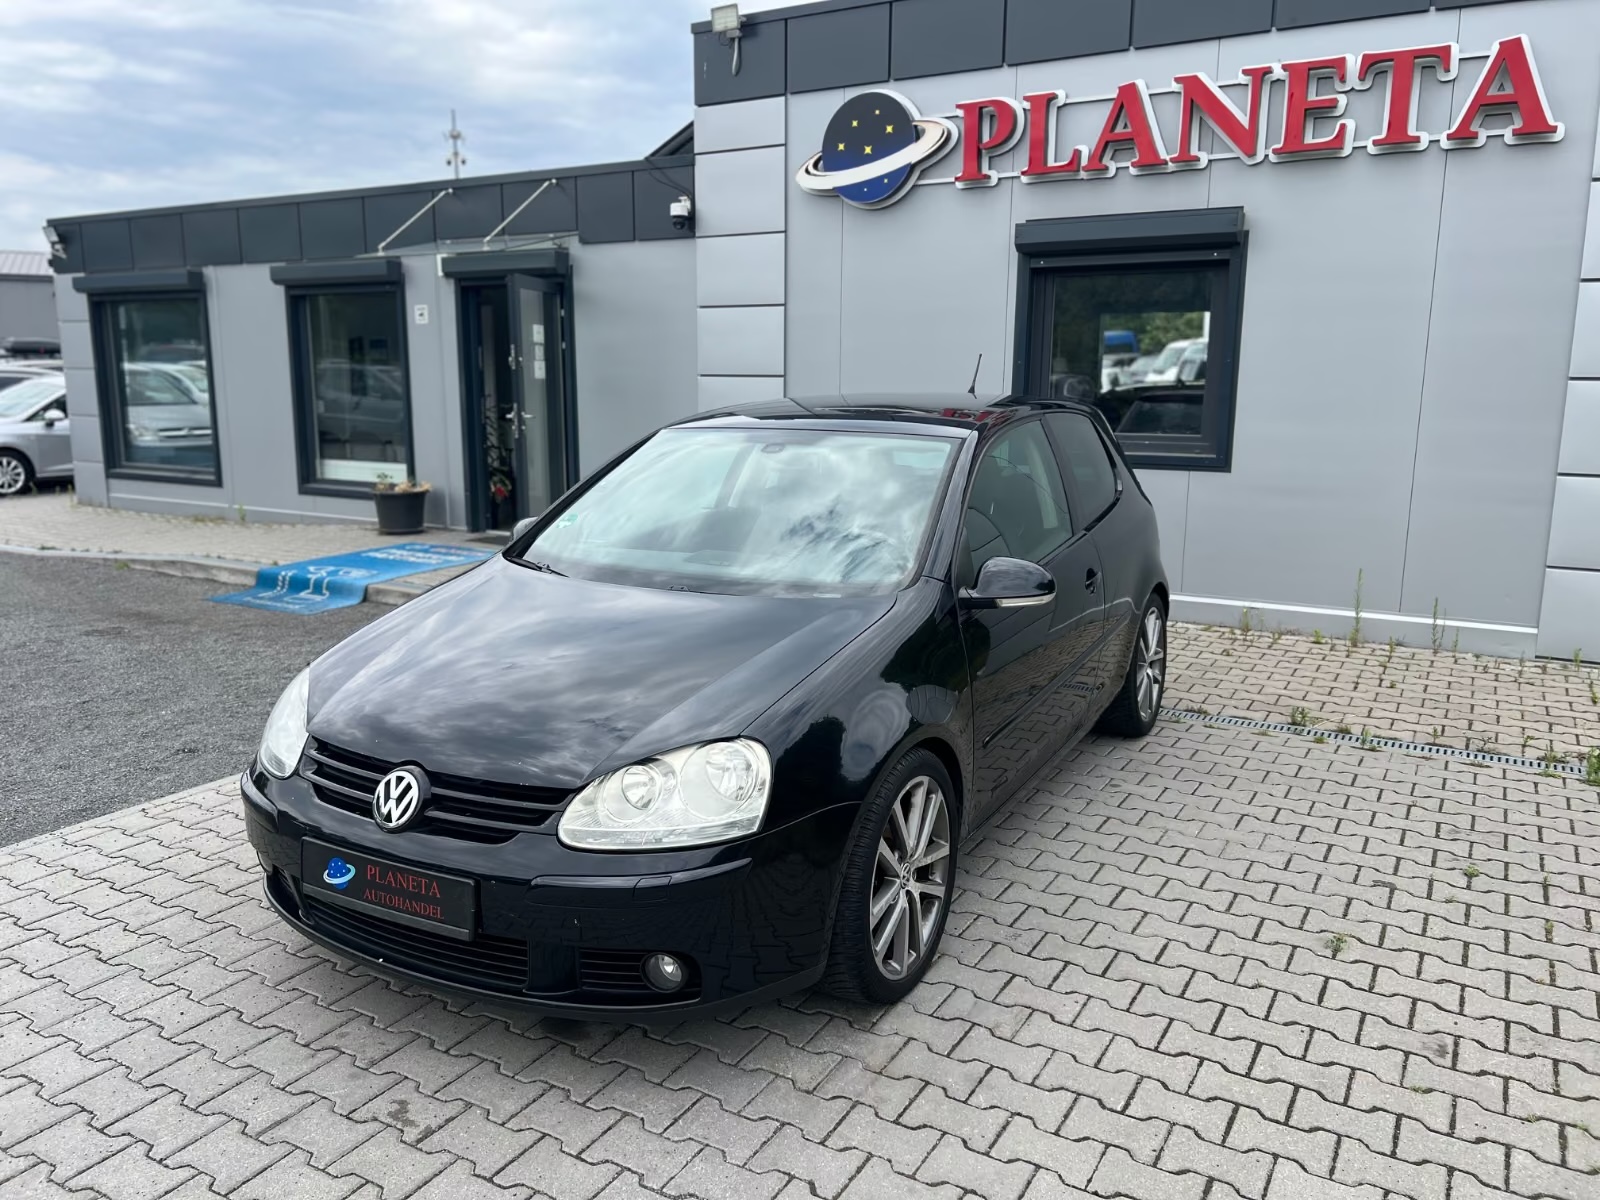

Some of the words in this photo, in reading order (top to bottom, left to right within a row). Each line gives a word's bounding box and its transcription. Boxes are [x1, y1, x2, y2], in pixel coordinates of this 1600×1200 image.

[955, 36, 1560, 183] PLANETA
[373, 769, 419, 827] VW
[364, 888, 444, 919] AUTOHANDEL
[367, 865, 441, 897] PLANETA
